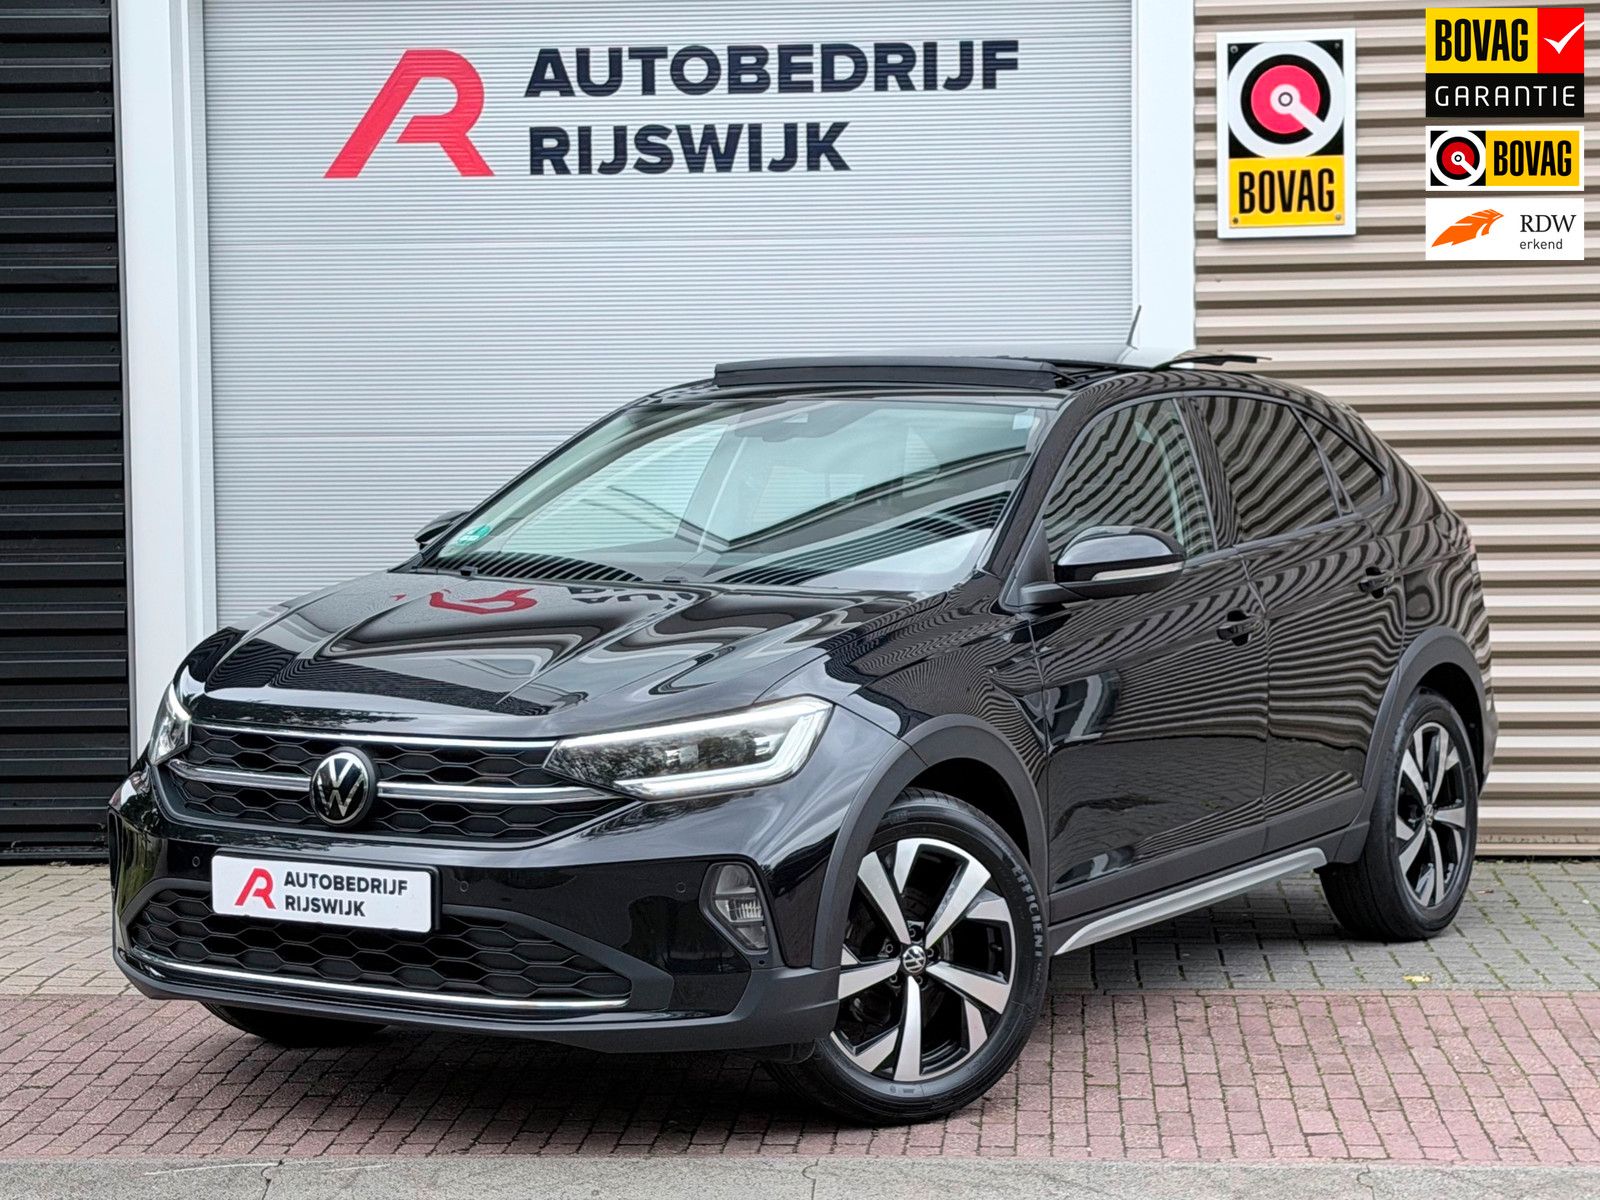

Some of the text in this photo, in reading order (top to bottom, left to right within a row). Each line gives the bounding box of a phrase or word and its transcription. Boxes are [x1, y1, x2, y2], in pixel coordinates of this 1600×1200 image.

[525, 40, 1019, 98] AUTOBEDRIJF
[529, 121, 850, 176] RIJSWIJK
[1238, 168, 1335, 214] BOVAG
[284, 870, 408, 896] AUTOBEDRIJF
[284, 894, 366, 917] RIJSWIJK
